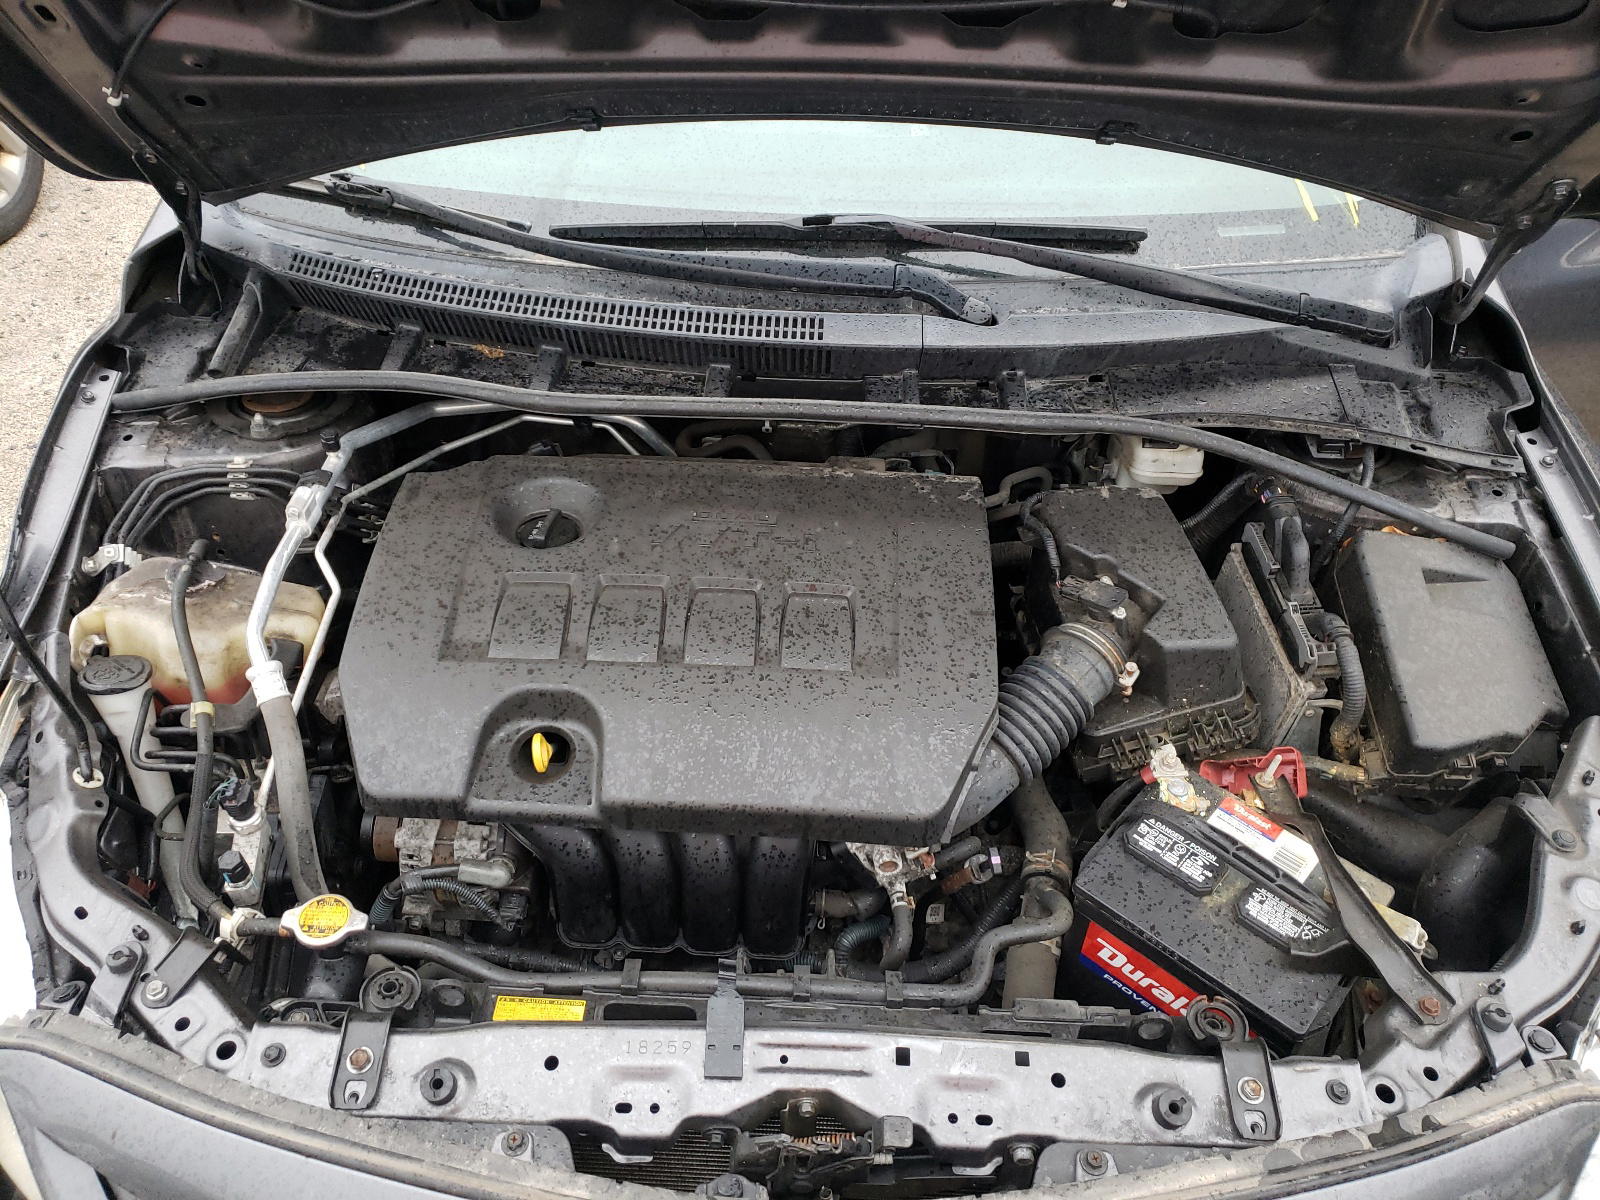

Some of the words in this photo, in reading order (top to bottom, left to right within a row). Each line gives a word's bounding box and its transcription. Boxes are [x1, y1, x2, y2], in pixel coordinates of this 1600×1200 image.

[1155, 822, 1185, 842] DANGER
[1189, 842, 1217, 862] POISON
[625, 1040, 692, 1055] 18259
